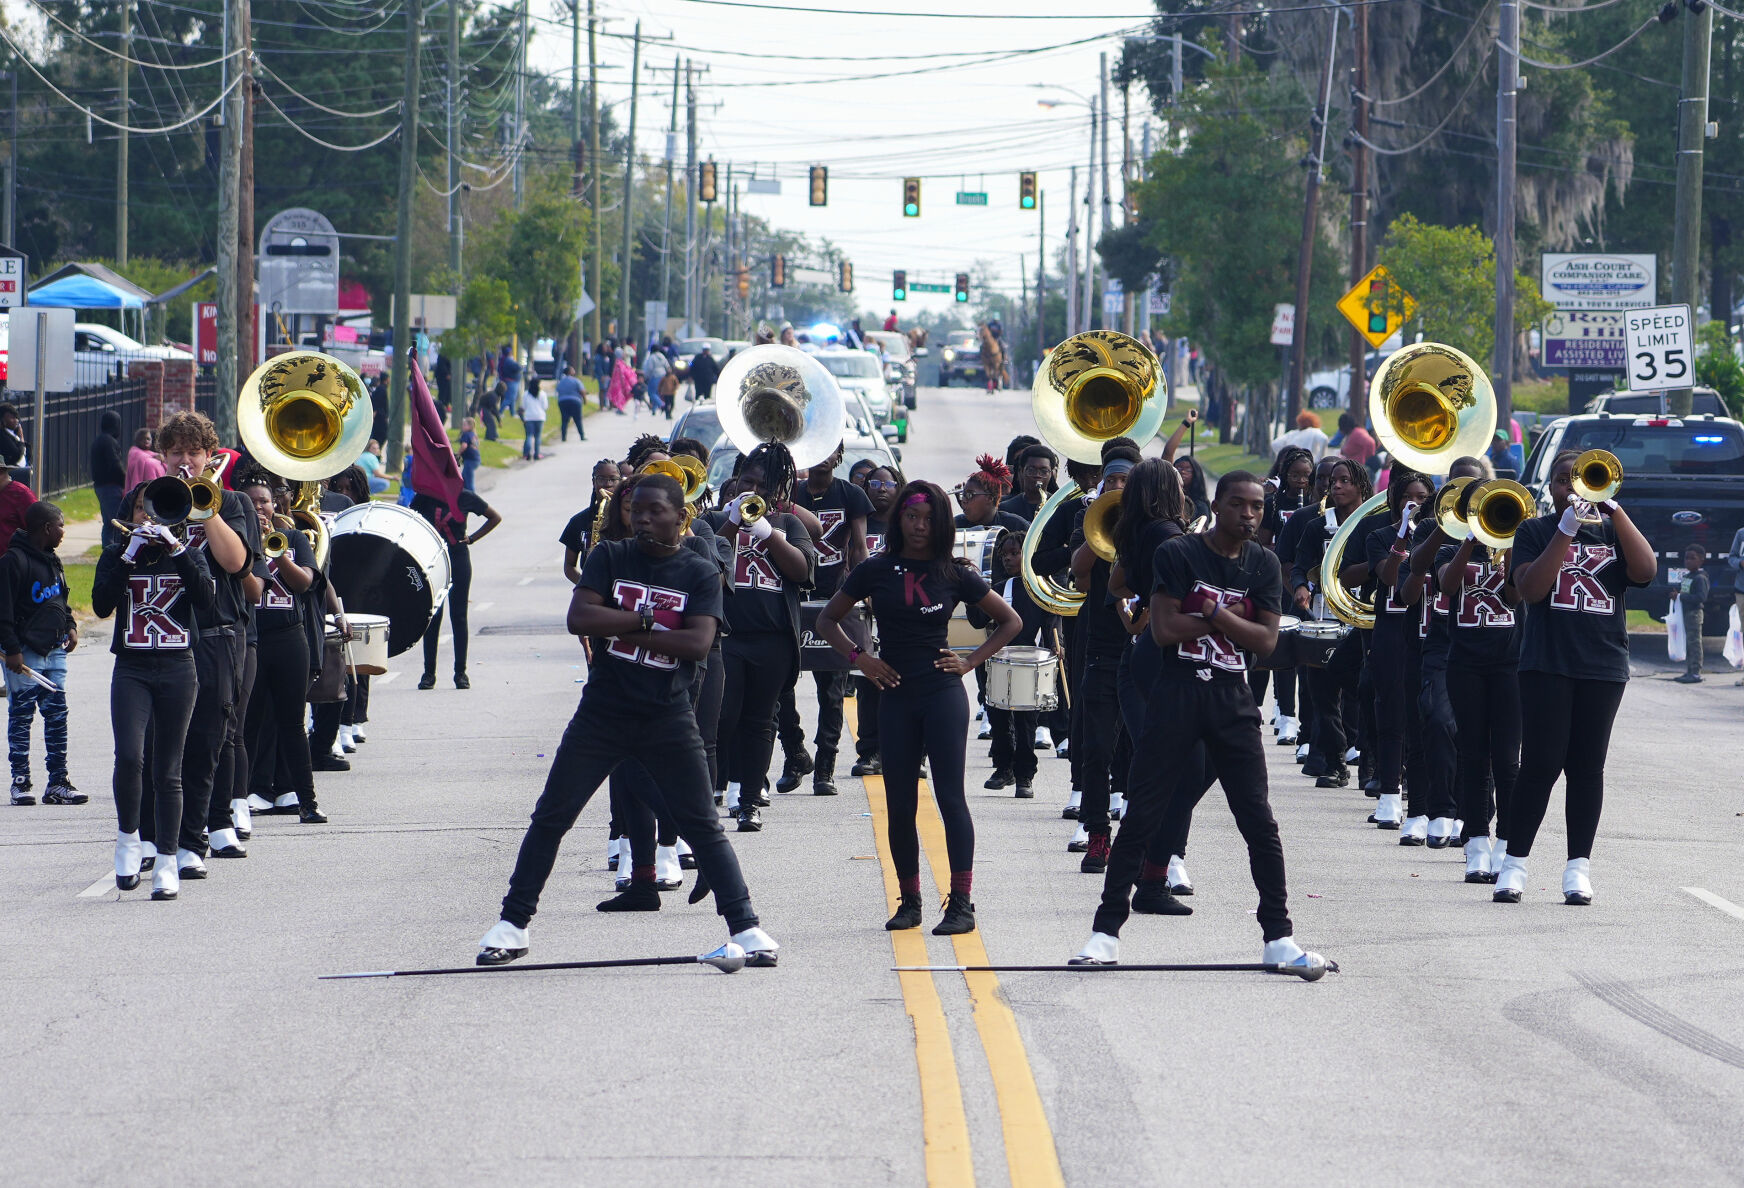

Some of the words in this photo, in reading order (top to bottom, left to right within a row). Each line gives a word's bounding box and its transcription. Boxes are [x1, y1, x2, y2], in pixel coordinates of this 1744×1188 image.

[203, 306, 218, 319] KIN
[1630, 316, 1684, 331] SPEED
[1565, 340, 1625, 350] RESIDENTIA
[1637, 333, 1679, 347] LIMIT
[1555, 350, 1605, 359] ASSISTED
[1608, 351, 1624, 359] LIV
[1635, 349, 1688, 381] 35
[1550, 541, 1617, 615] K
[904, 572, 931, 606] K
[1457, 561, 1516, 628] K
[123, 574, 190, 650] K
[800, 630, 832, 648] Pear
